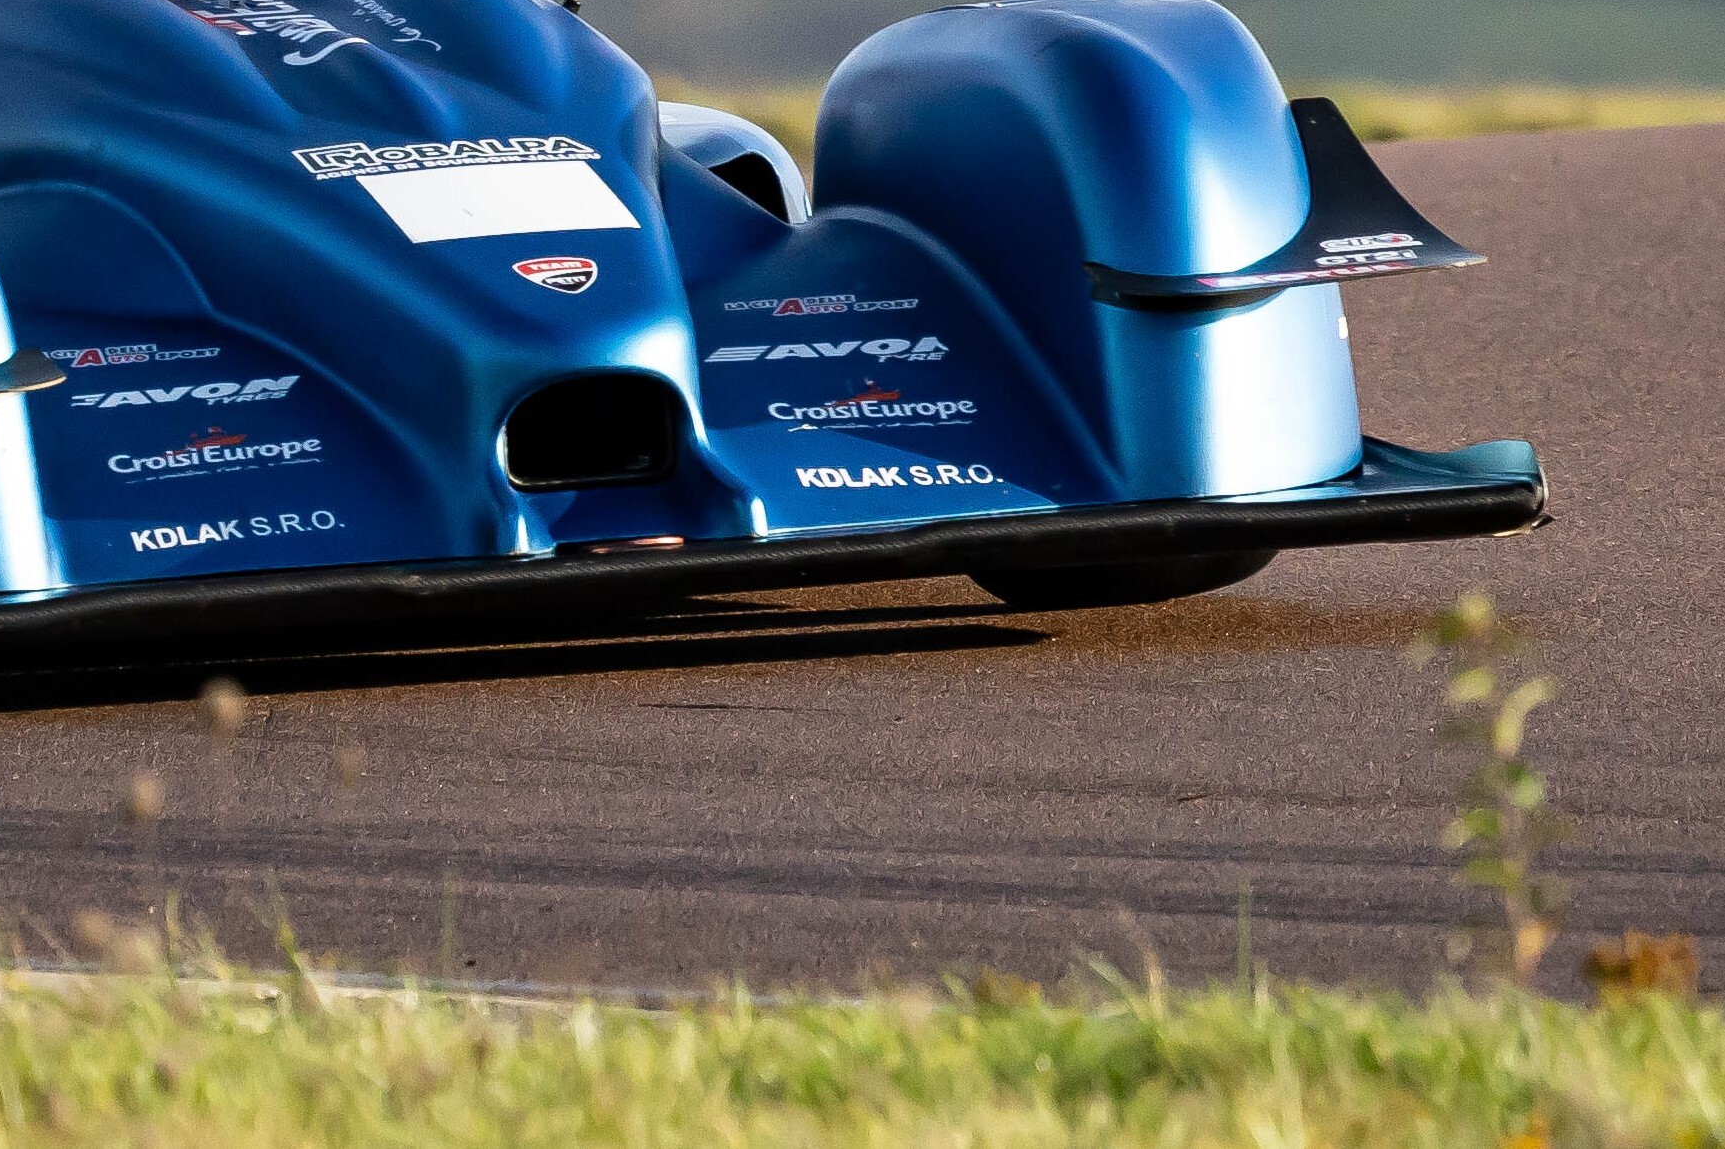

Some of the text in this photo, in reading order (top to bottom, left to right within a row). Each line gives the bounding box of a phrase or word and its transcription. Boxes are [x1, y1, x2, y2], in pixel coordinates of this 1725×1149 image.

[290, 136, 595, 174] MOBALPA
[853, 298, 919, 312] SPORT
[155, 347, 221, 361] SPORT
[97, 375, 302, 408] AVON
[767, 399, 978, 419] CroisiEurope
[107, 437, 324, 474] CroisiEurope
[795, 463, 1005, 488] KDLAK S.R.O.
[129, 509, 346, 552] KDLAK S.R.O.
